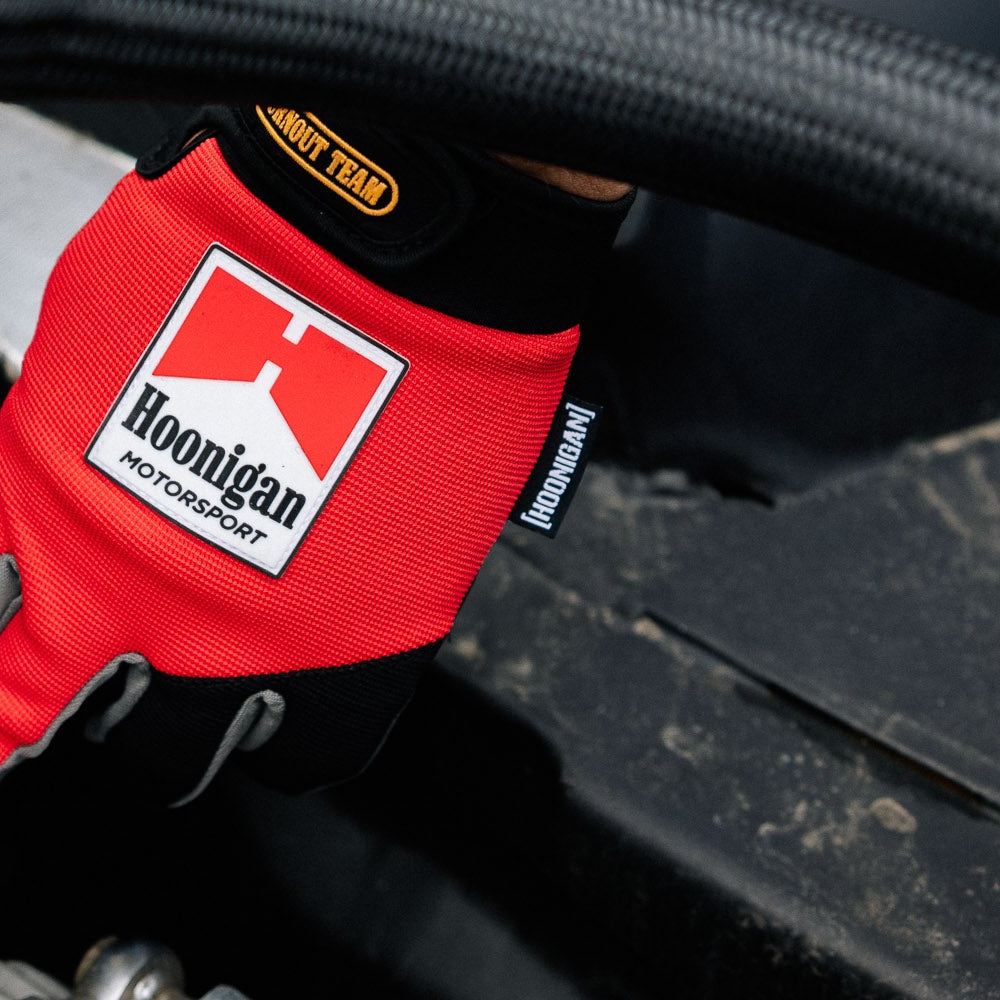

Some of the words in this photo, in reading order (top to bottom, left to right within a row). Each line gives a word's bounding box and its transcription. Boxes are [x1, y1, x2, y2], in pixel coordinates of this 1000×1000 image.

[325, 149, 388, 206] TEAM
[119, 450, 268, 544] MOTORSPORT
[121, 382, 307, 530] Hoonigan
[520, 402, 596, 530] [HOONIGAN]
